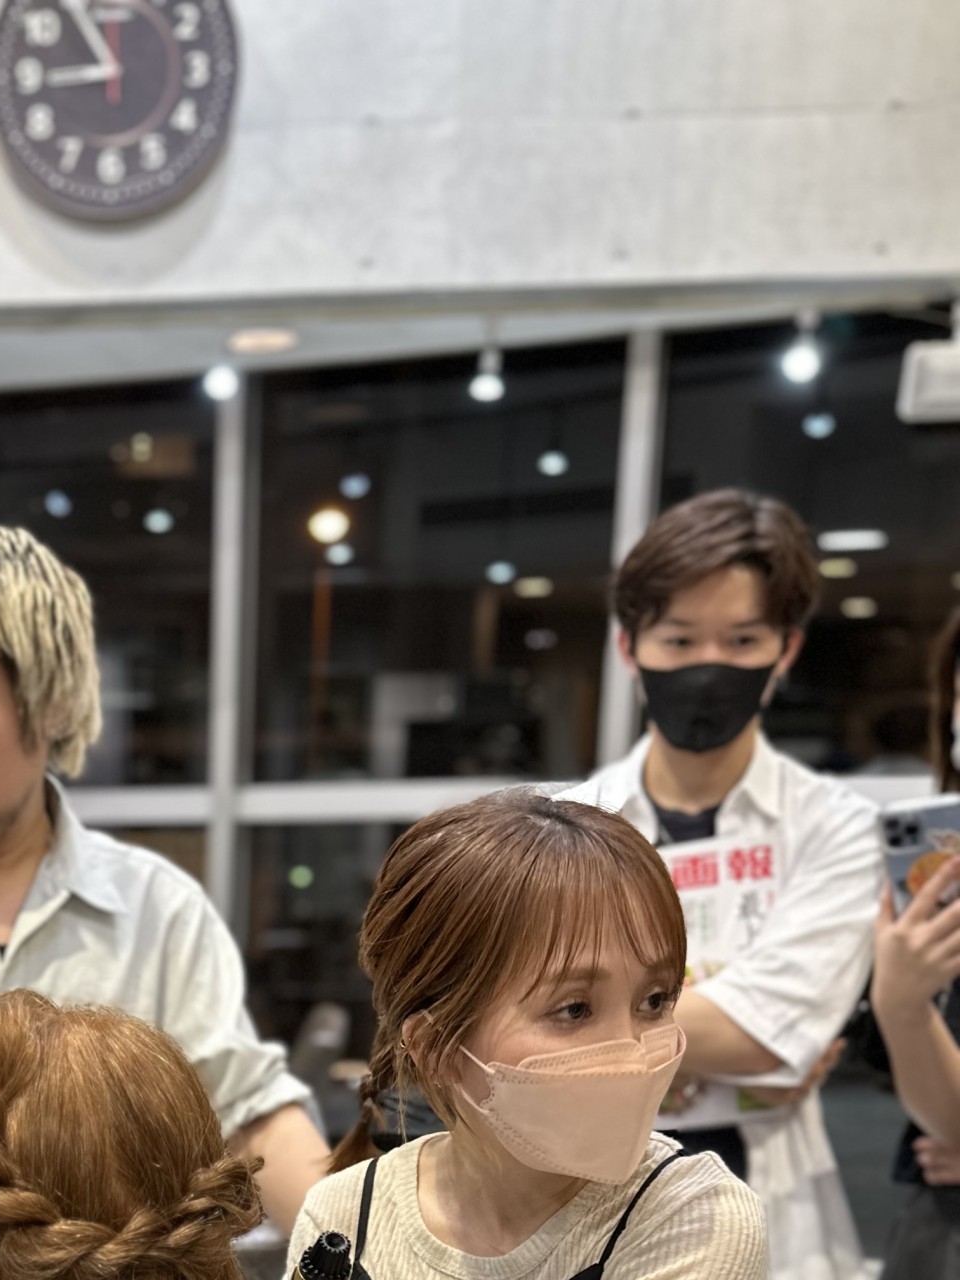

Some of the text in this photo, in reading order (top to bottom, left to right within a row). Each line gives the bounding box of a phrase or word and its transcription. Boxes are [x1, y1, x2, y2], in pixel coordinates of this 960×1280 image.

[23, 6, 62, 47] 10
[172, 2, 201, 42] 2
[14, 56, 43, 95] 9
[184, 49, 211, 89] 3
[25, 102, 55, 142] 8
[169, 97, 197, 135] 4
[56, 135, 84, 174] 7
[96, 147, 127, 185] 6
[141, 133, 167, 171] 5
